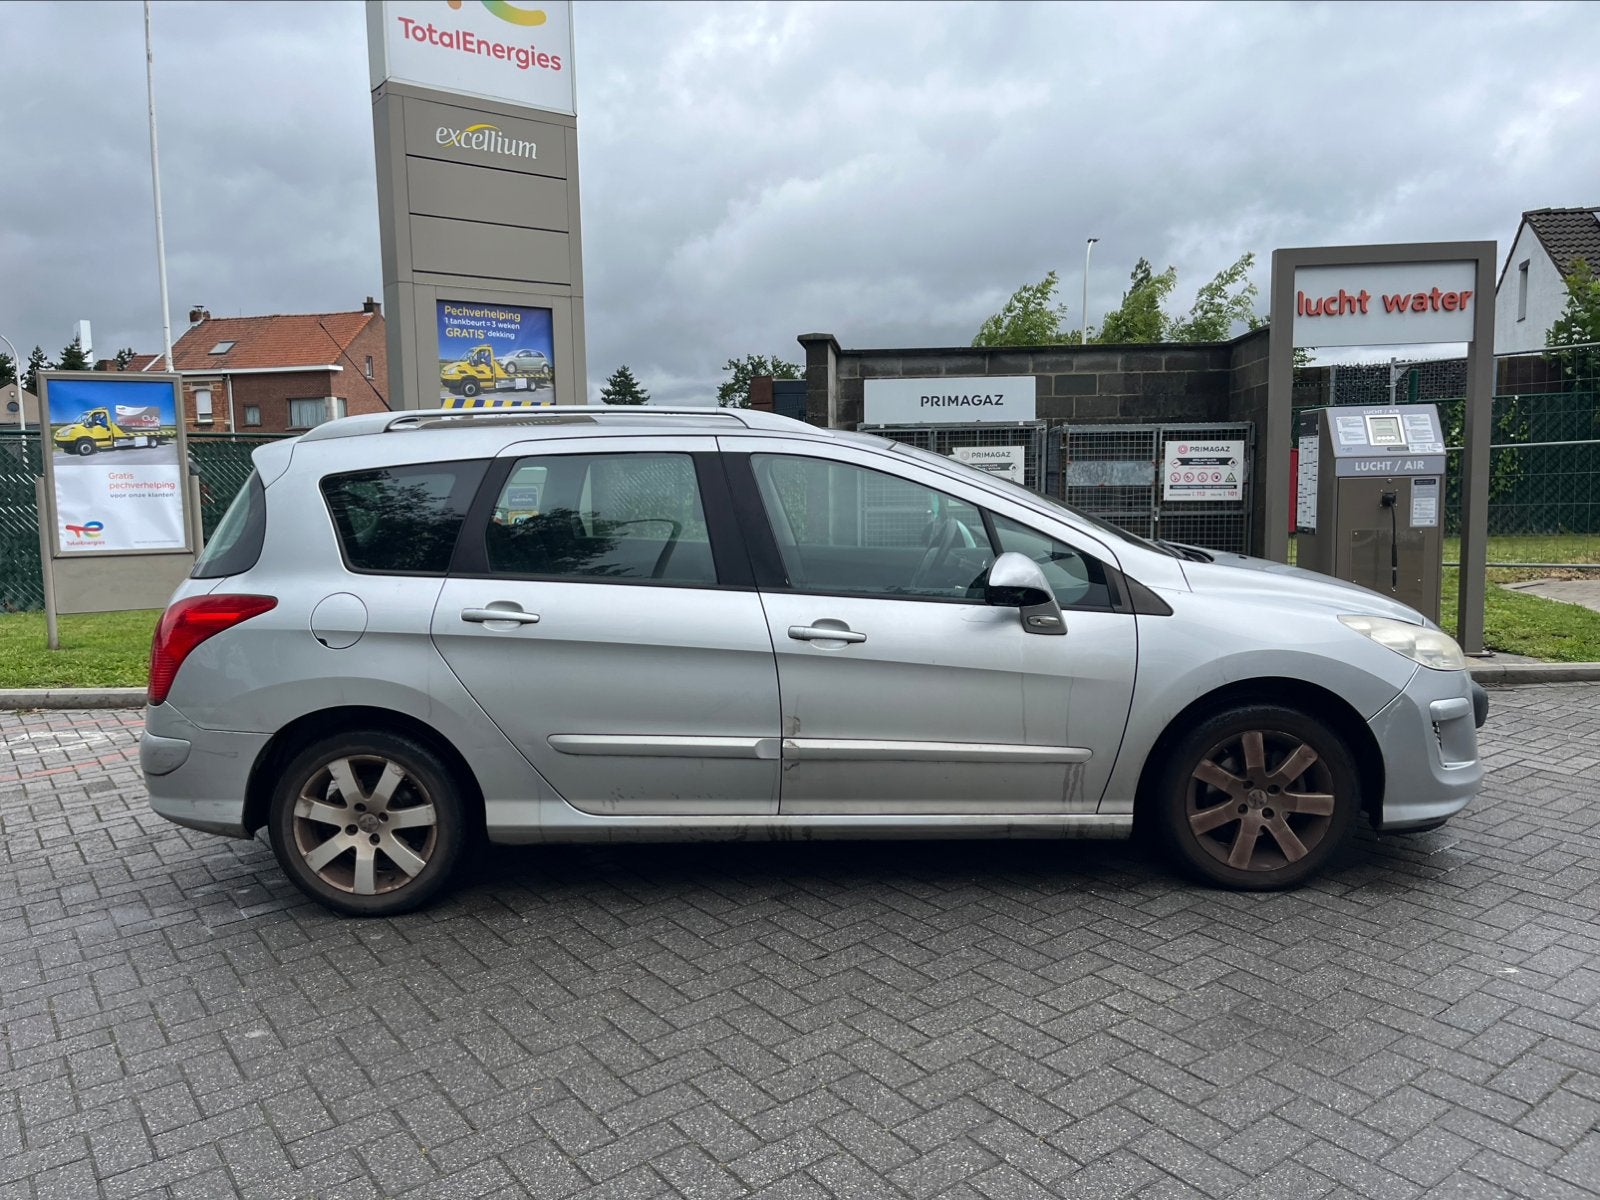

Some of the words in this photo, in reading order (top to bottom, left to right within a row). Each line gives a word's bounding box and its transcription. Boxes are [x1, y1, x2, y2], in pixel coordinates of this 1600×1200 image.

[398, 16, 562, 71] TotalEnergies
[435, 125, 537, 160] excellium
[1297, 289, 1371, 317] lucht
[1382, 287, 1473, 313] water
[444, 305, 521, 322] Pechverhelping
[450, 318, 486, 327] tankbeurt
[498, 322, 520, 330] weken
[487, 331, 516, 340] dekking
[920, 394, 1004, 408] PRIMAGAZ
[1355, 461, 1392, 472] LUCHT
[1394, 460, 1402, 472] /
[1404, 460, 1425, 470] AIR
[108, 472, 134, 480] Gratis
[109, 482, 176, 490] pechverhelping
